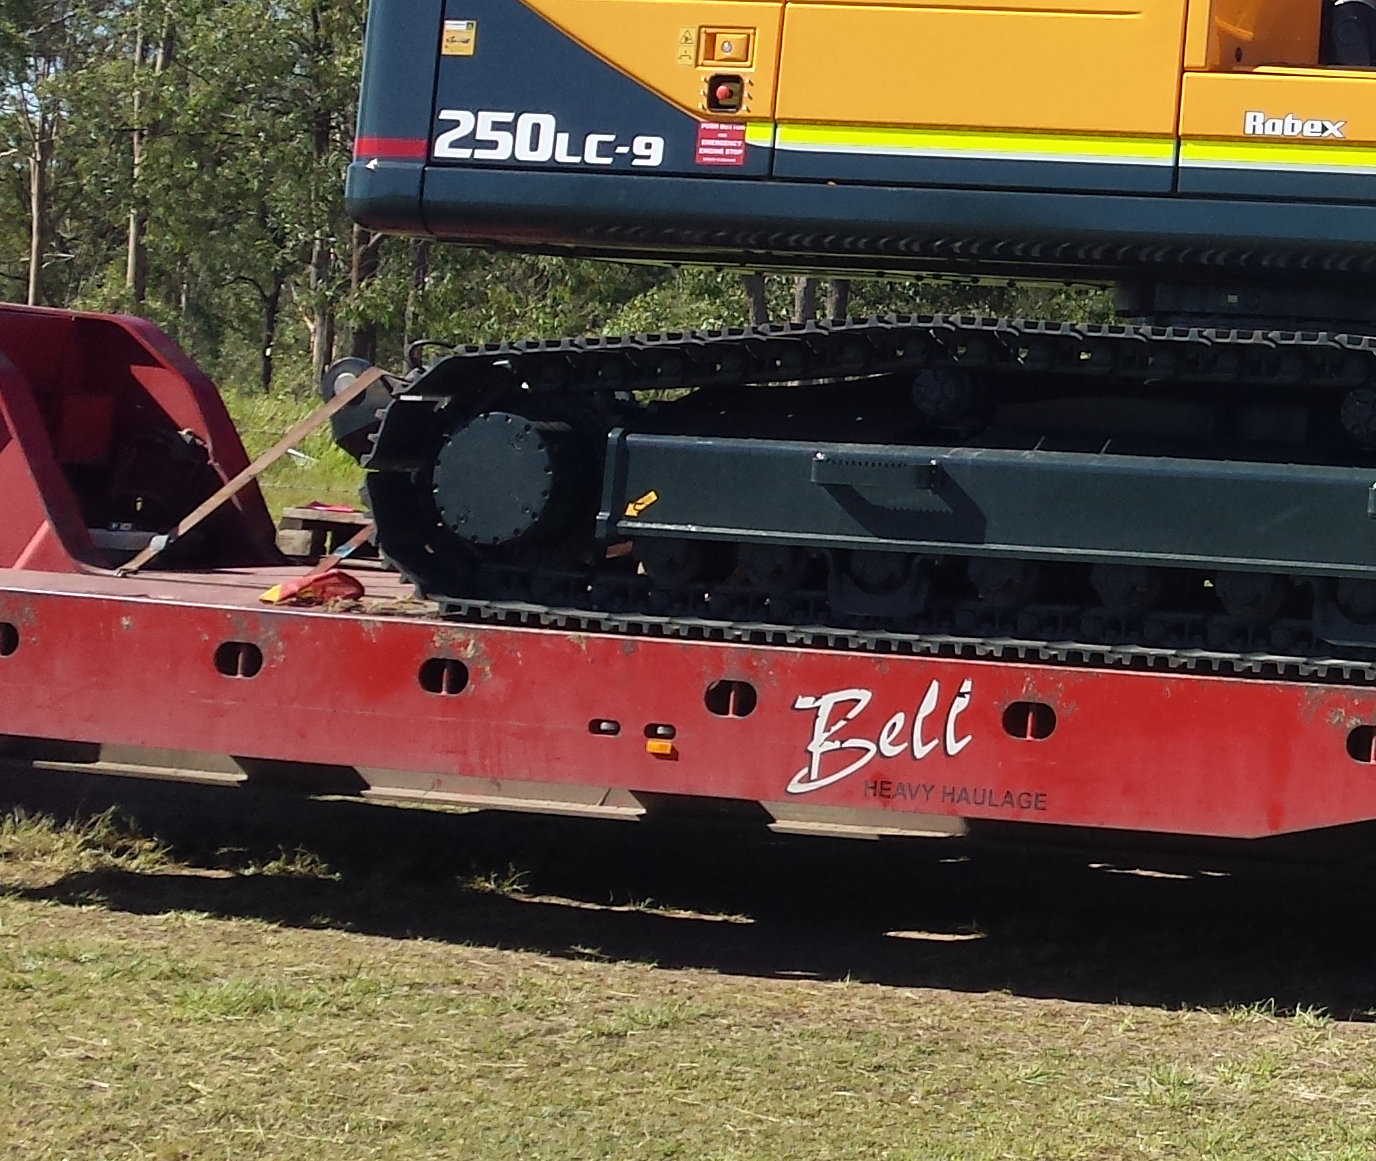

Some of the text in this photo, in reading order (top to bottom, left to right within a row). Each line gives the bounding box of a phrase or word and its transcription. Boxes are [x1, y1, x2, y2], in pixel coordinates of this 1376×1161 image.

[434, 109, 665, 167] 250LC-9
[1243, 110, 1347, 139] Robex
[864, 780, 1048, 811] HEAVY HAULAGE
